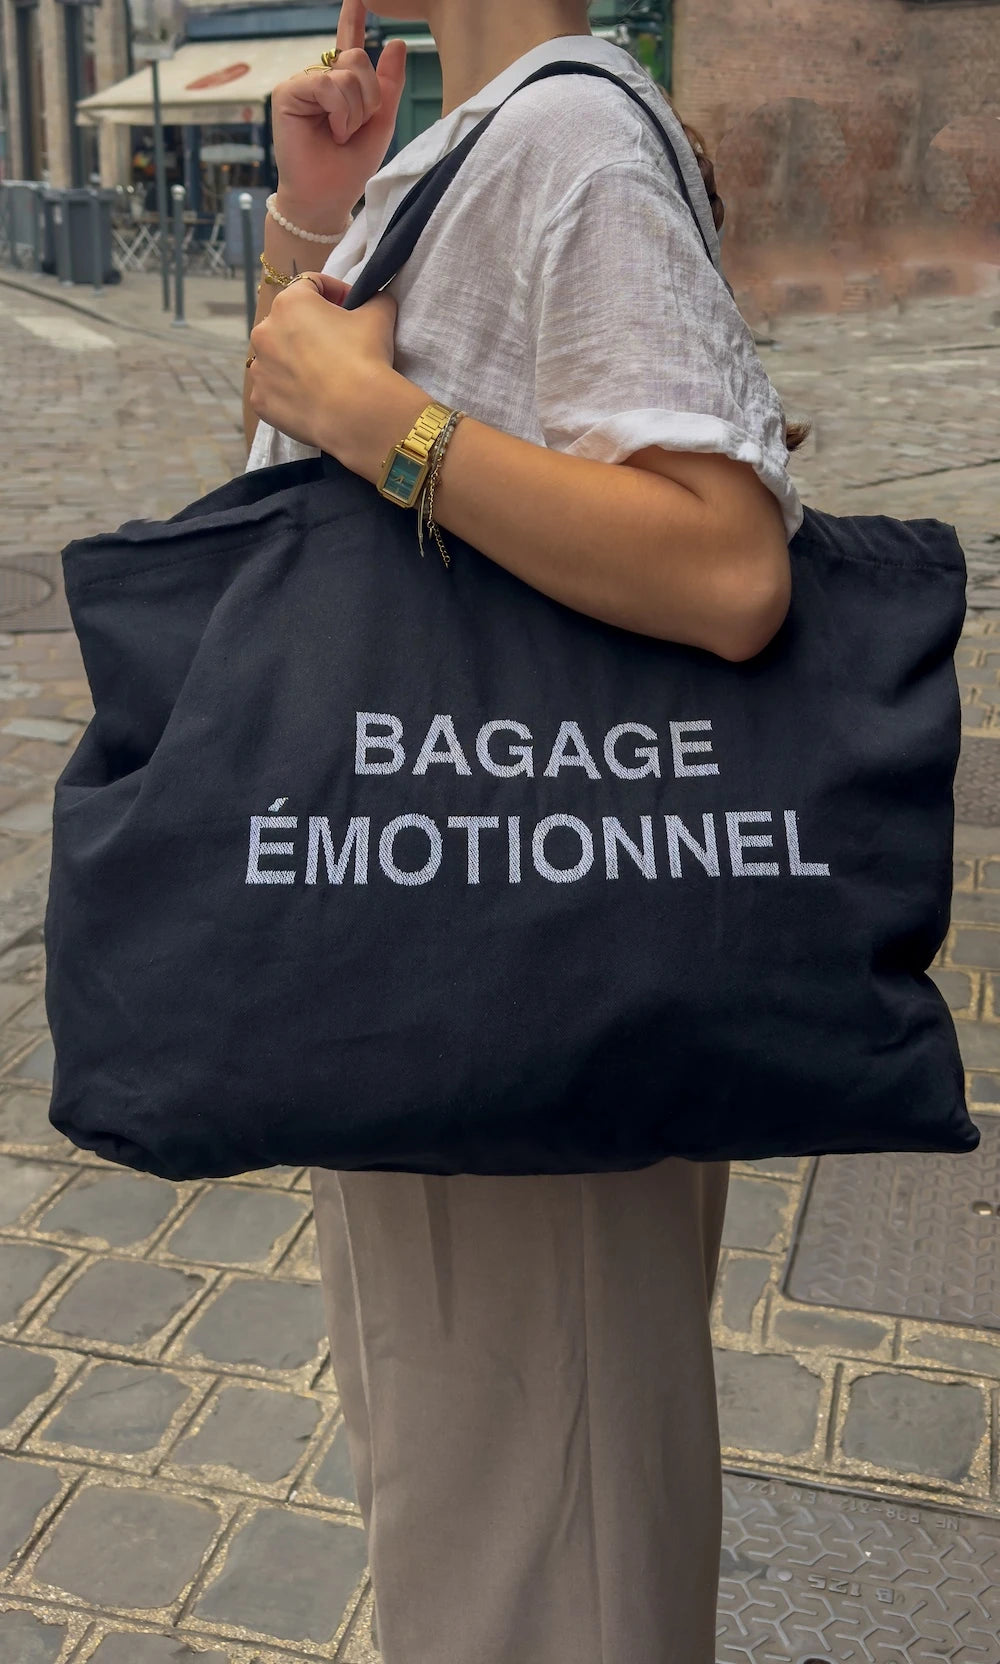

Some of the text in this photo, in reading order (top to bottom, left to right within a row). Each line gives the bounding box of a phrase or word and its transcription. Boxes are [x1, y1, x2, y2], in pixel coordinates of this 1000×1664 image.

[354, 711, 720, 780] BAGAGE
[245, 797, 830, 886] ÉMOTIONNEL
[936, 1517, 959, 1531] NF
[807, 1574, 895, 1604] B 125
